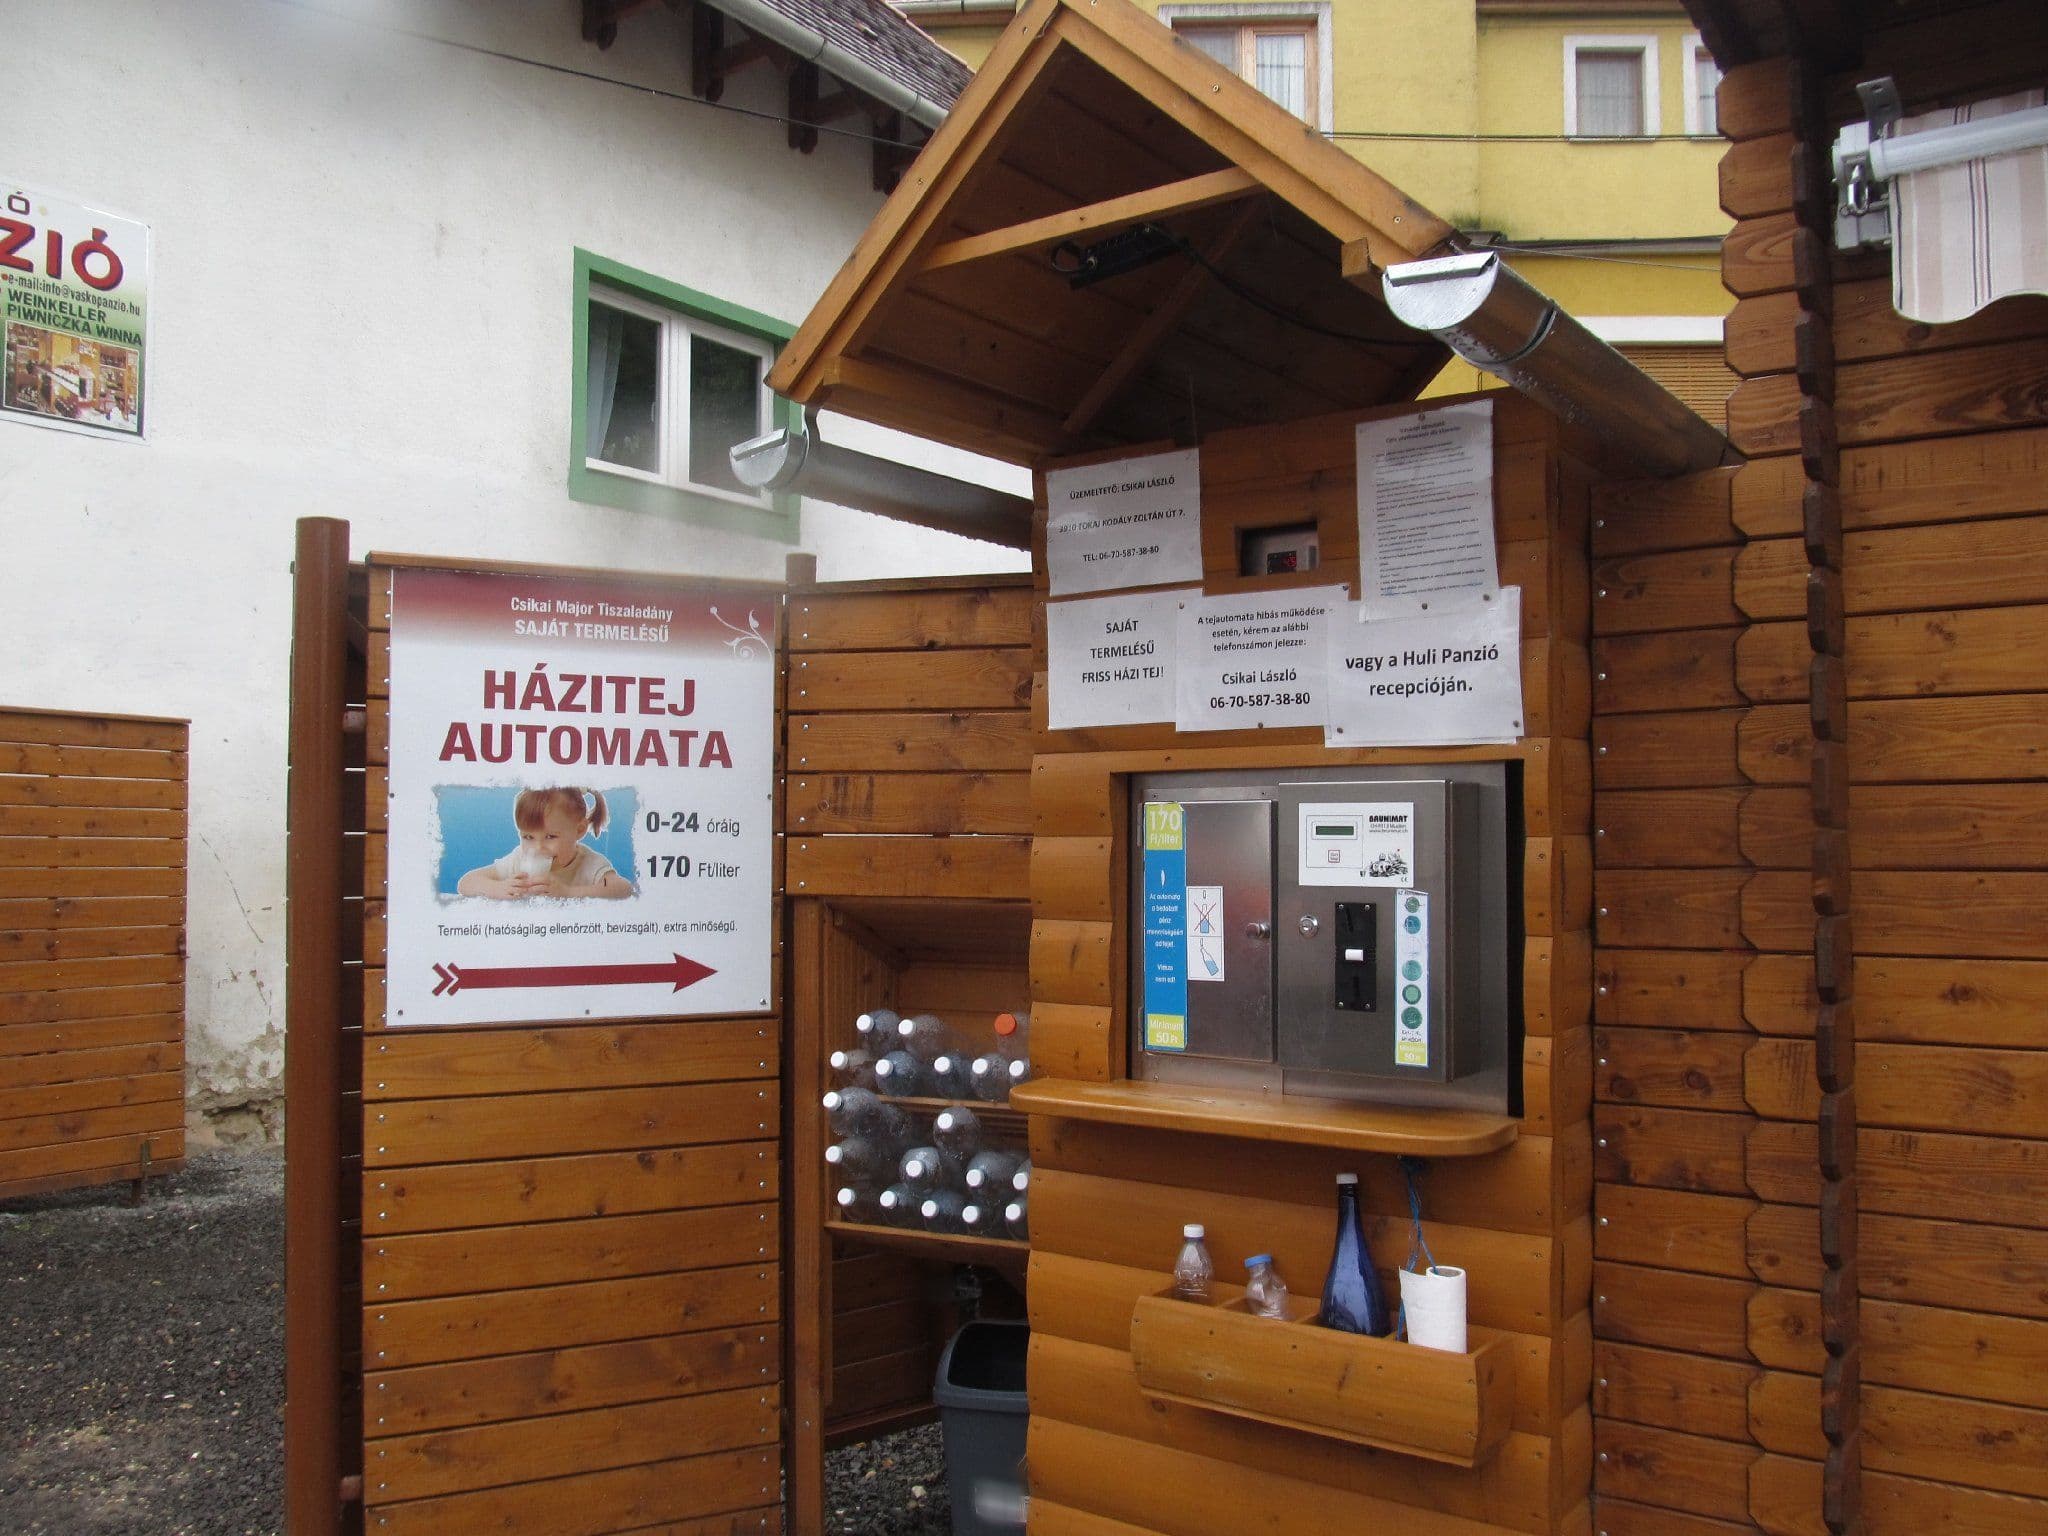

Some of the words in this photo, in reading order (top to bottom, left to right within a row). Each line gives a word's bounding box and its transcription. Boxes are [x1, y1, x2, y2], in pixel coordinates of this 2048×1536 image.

[8, 273, 140, 316] e-mail:info@vaskopanzio.hu
[8, 288, 107, 323] WEINKELLER
[7, 304, 92, 334] PIWNICZKA
[96, 325, 142, 346] WINNA
[1121, 481, 1145, 492] CSIKAI
[1102, 516, 1131, 526] KODÁLY
[1134, 511, 1163, 522] ZOLTÁN
[511, 597, 551, 613] Csikai
[556, 600, 594, 617] Major
[597, 603, 673, 622] Tiszaladány
[1205, 612, 1254, 625] tejautomata
[1256, 610, 1279, 620] hibás
[1281, 606, 1325, 618] működése
[515, 618, 569, 637] SAJÁT
[574, 622, 669, 643] TERMELÉSŰ
[1106, 619, 1139, 634] SAJÁT
[1212, 628, 1241, 638] esetén,
[1243, 626, 1269, 635] kérem
[1282, 622, 1309, 631] alábbi
[1090, 640, 1154, 659] TERMELÉSŰ
[1213, 640, 1273, 652] telefonszámon
[1274, 638, 1306, 649] jelezze:
[1345, 655, 1384, 672] vagy
[1388, 655, 1397, 667] a
[1403, 649, 1436, 666] Huli
[1442, 644, 1499, 663] Panzió
[1082, 671, 1111, 683] FRISS
[1114, 667, 1140, 682] HÁZI
[1143, 666, 1164, 679] TEJ!
[1222, 669, 1256, 685] Csikai
[1260, 668, 1297, 684] László
[484, 663, 695, 716] HÁZITEJ
[1369, 675, 1473, 697] recepcióján.
[1210, 692, 1310, 709] 06-70-587-38-80
[439, 722, 733, 768] AUTOMATA
[646, 811, 700, 833] 0-24
[706, 817, 740, 837] óráig
[1150, 808, 1181, 831] 170
[646, 856, 690, 878] 170
[698, 862, 740, 878] Ft/liter
[438, 924, 481, 936] Termelői
[484, 923, 547, 938] (hatóságilag
[664, 921, 687, 932] extra
[690, 920, 738, 934] minőségű.
